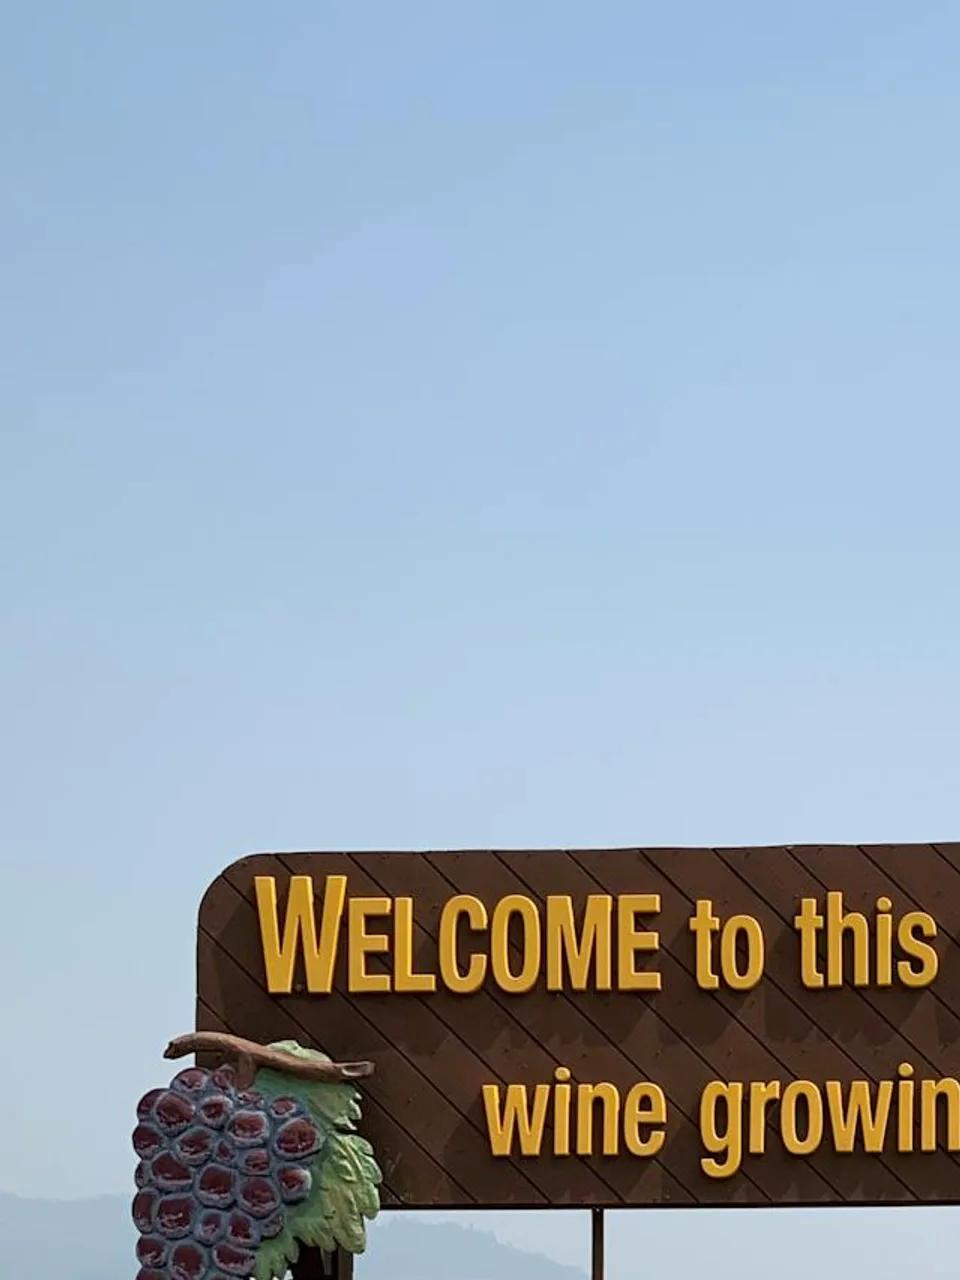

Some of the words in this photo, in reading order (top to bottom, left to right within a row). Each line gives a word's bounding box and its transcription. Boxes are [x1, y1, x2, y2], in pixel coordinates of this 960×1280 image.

[254, 875, 662, 994] WELCOME
[689, 899, 765, 990] to
[794, 891, 939, 989] this
[481, 1067, 668, 1157] wine
